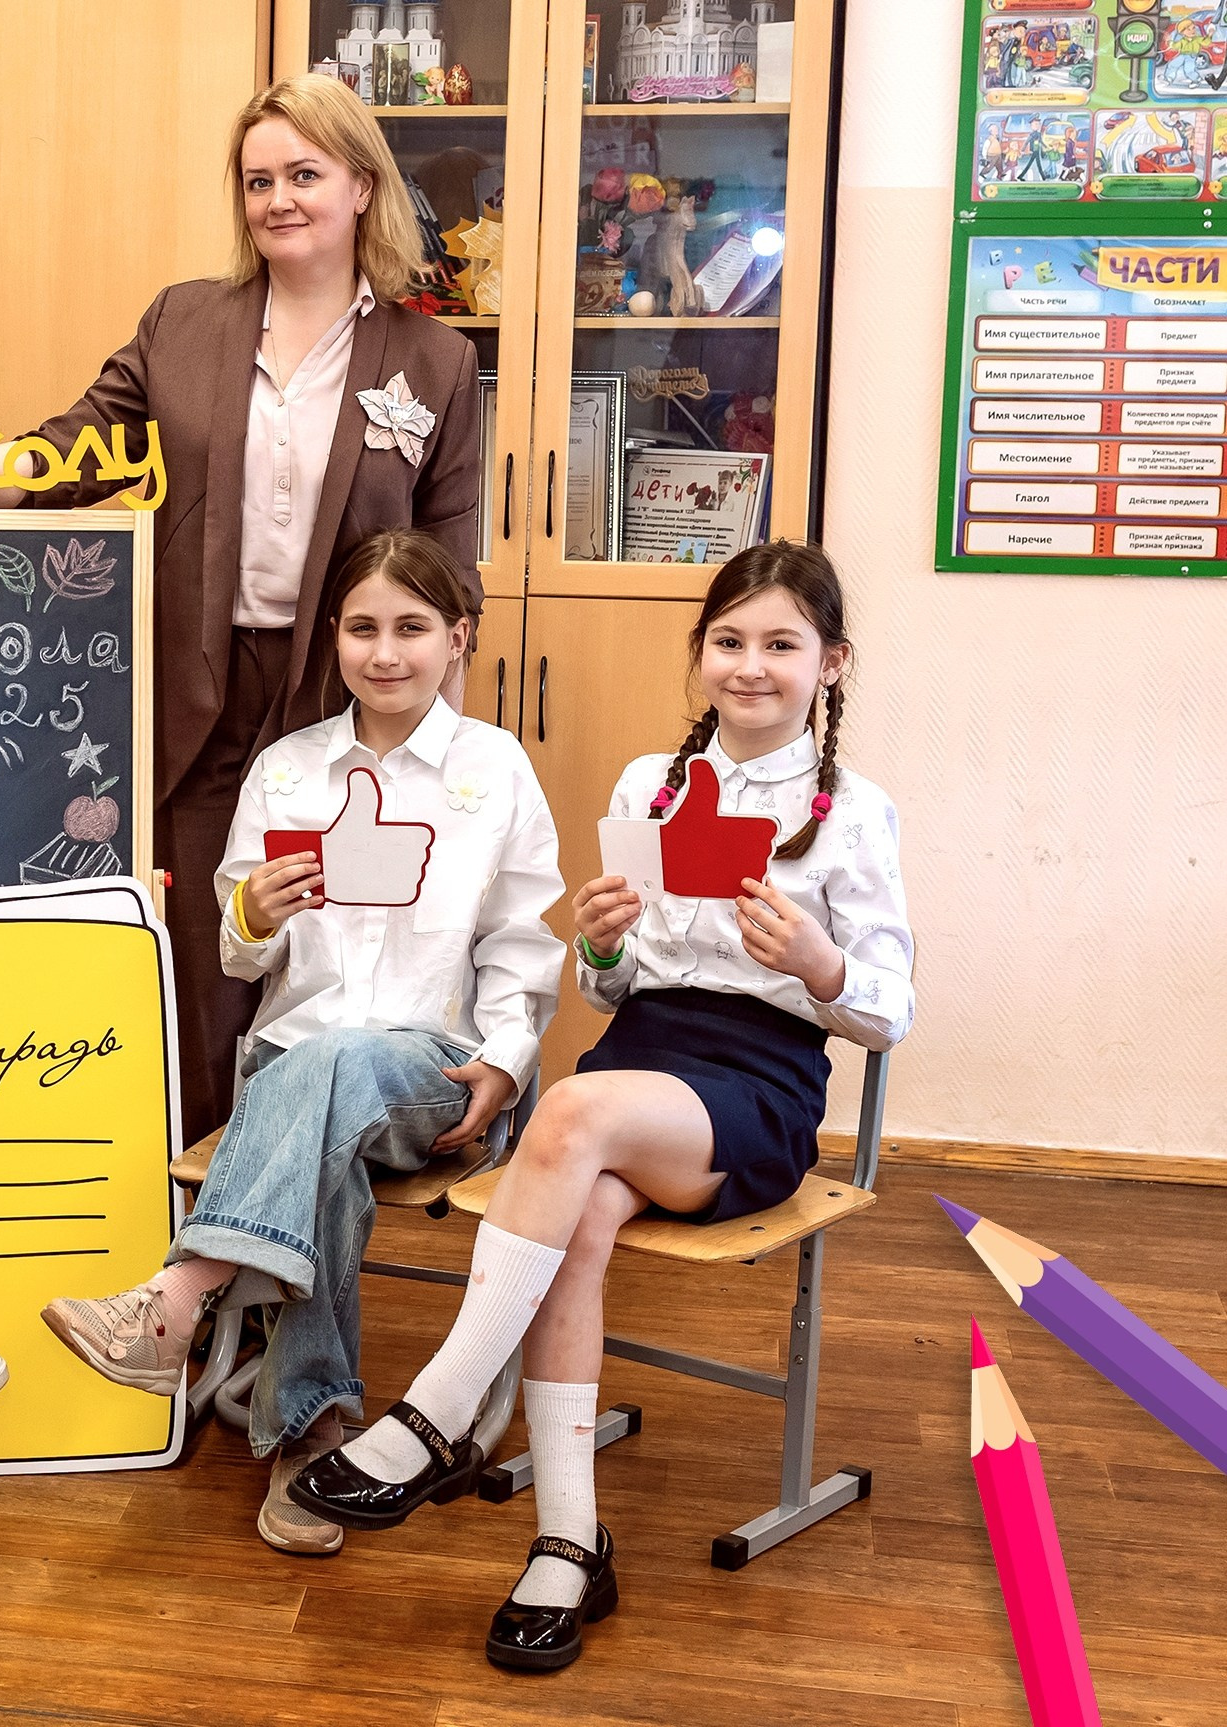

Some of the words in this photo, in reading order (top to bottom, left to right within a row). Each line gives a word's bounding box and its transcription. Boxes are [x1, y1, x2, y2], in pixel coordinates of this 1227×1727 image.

[1127, 34, 1148, 43] ИДИ!
[1109, 257, 1220, 284] ЧАСТИ
[984, 329, 1007, 339] Имя
[1009, 329, 1101, 341] существительное
[1160, 332, 1198, 341] Предмет
[985, 370, 1008, 379] Имя
[1010, 371, 1094, 382] прилагательное
[1160, 368, 1194, 376] Признак
[1156, 378, 1197, 386] предмета
[988, 411, 1010, 420] Имя
[1012, 412, 1086, 422] числительное
[1127, 410, 1170, 418] Количество
[1186, 412, 1218, 420] порядок
[1134, 419, 1175, 428] предметов
[1176, 420, 1191, 428] при
[1192, 419, 1212, 427] счёте
[999, 453, 1072, 463] Местоимение
[1152, 449, 1191, 457] Указывает
[1137, 456, 1178, 465] предметы,
[1179, 457, 1217, 465] признаки,
[1015, 493, 1050, 503] Глагол
[1129, 497, 1168, 505] Действие
[1169, 498, 1209, 507] предмета
[1008, 534, 1053, 545] Наречие
[1128, 532, 1163, 540] Признак
[1164, 533, 1205, 542] действия,
[1129, 542, 1163, 550] признак
[1164, 542, 1203, 550] признака
